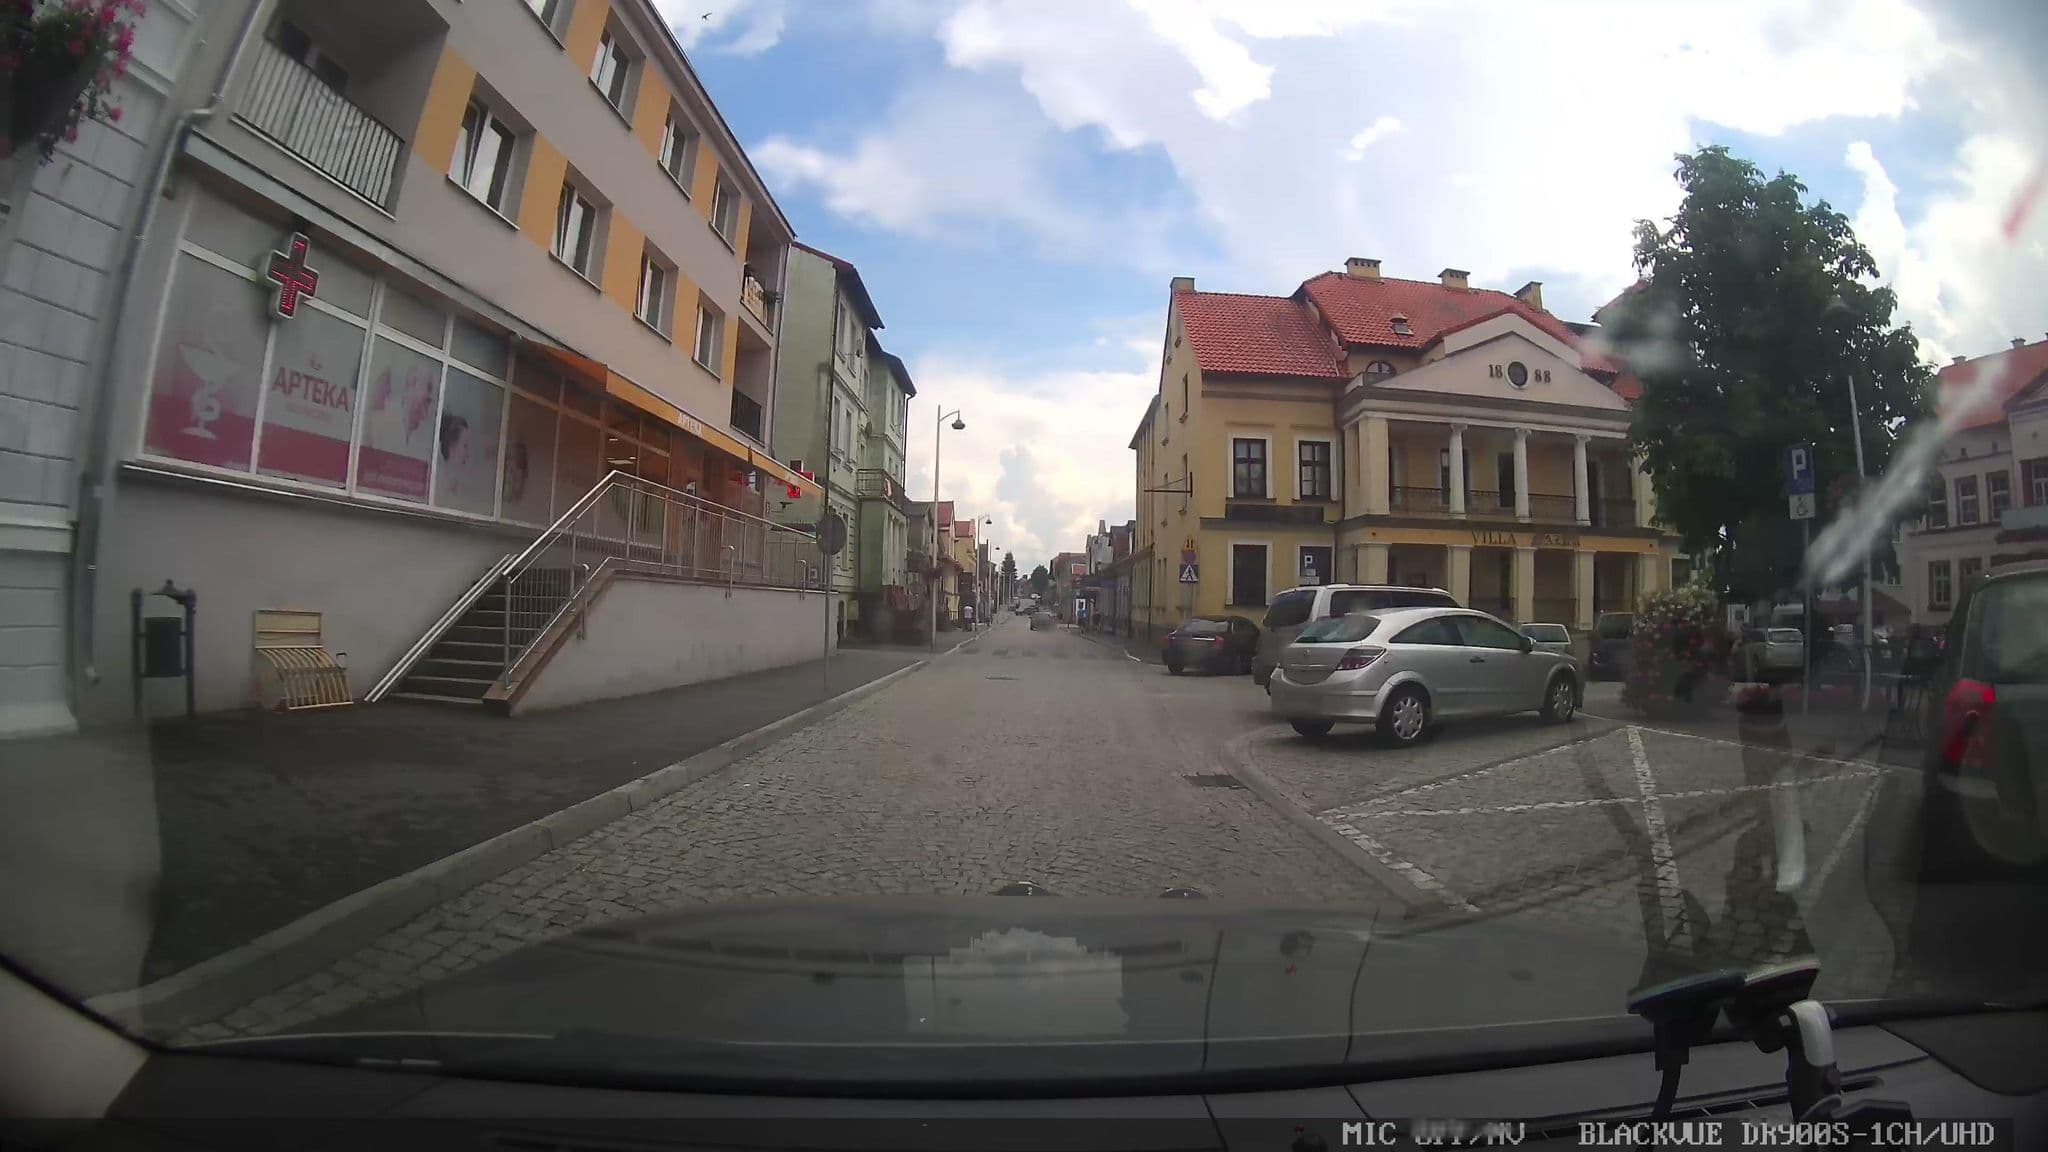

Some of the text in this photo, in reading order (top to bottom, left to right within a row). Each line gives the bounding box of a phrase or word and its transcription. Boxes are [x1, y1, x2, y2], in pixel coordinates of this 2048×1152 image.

[1488, 364, 1551, 383] 18 88
[272, 366, 349, 413] APTEKA
[1791, 448, 1807, 480] P
[1472, 529, 1517, 546] VILLA
[1304, 555, 1313, 567] P
